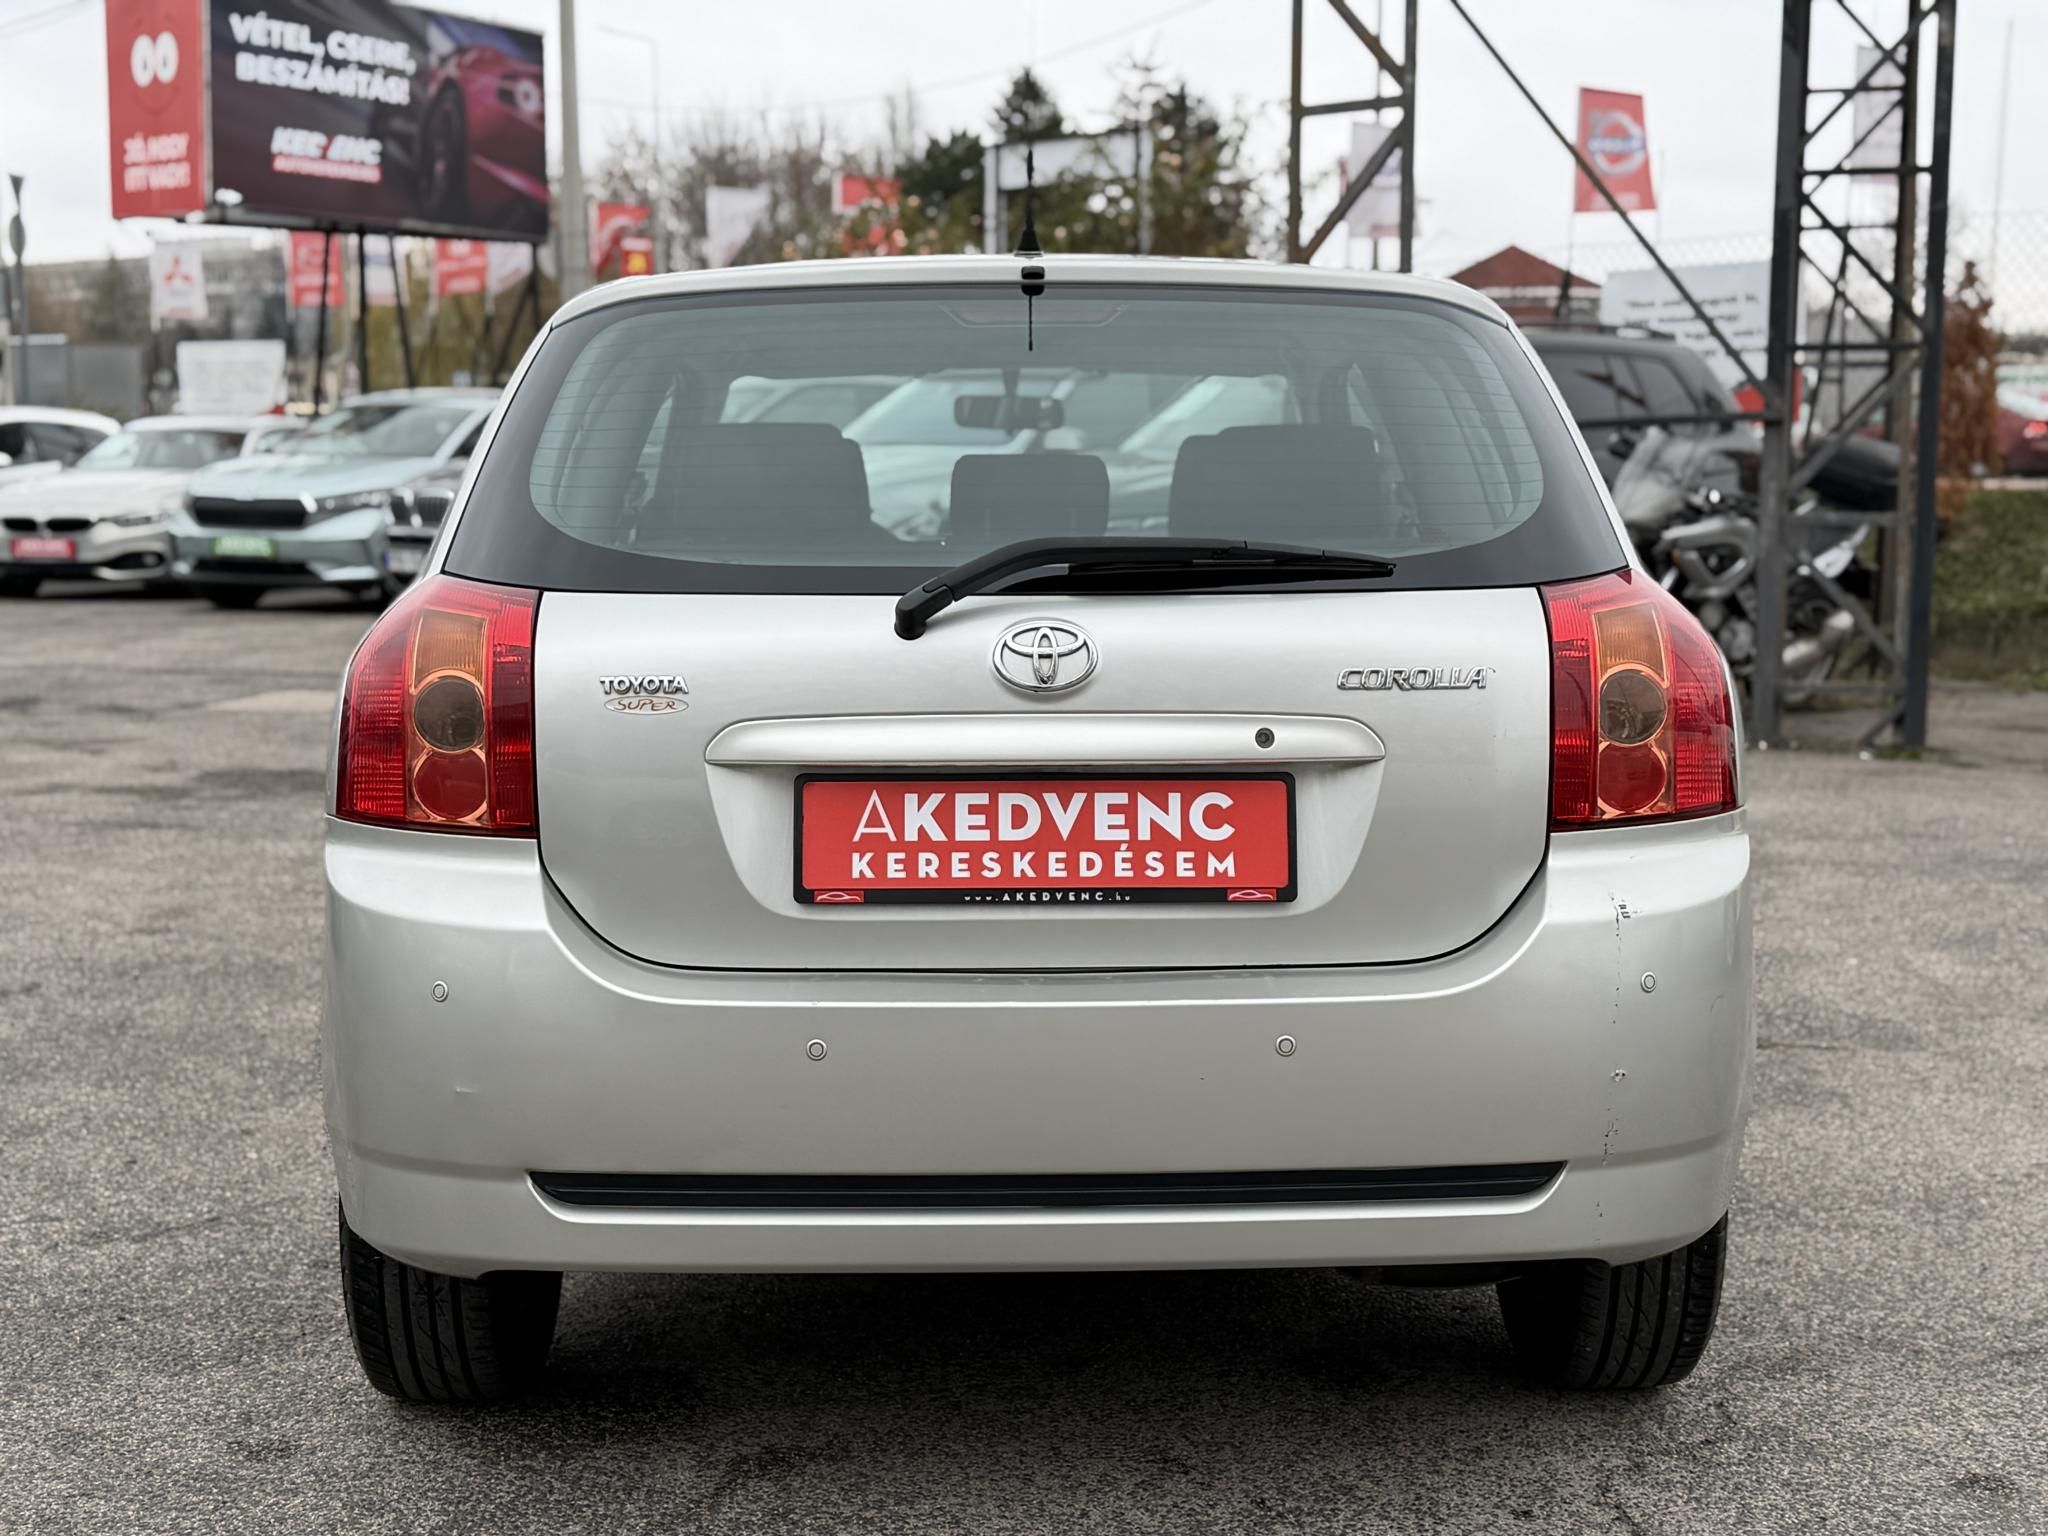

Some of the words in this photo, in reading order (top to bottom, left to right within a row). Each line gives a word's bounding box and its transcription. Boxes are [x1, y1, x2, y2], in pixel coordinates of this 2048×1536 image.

[229, 11, 325, 57] VÉTEL,
[327, 30, 416, 76] CSERE,
[235, 51, 410, 106] BESZÁMÍTÁS!
[600, 675, 689, 695] TOYOTA
[1337, 666, 1487, 691] COROLLA
[614, 698, 677, 711] SUPER
[851, 843, 1236, 879] KERESKEDÉSEM
[963, 891, 1131, 902] www.AKEDVENC.hu
